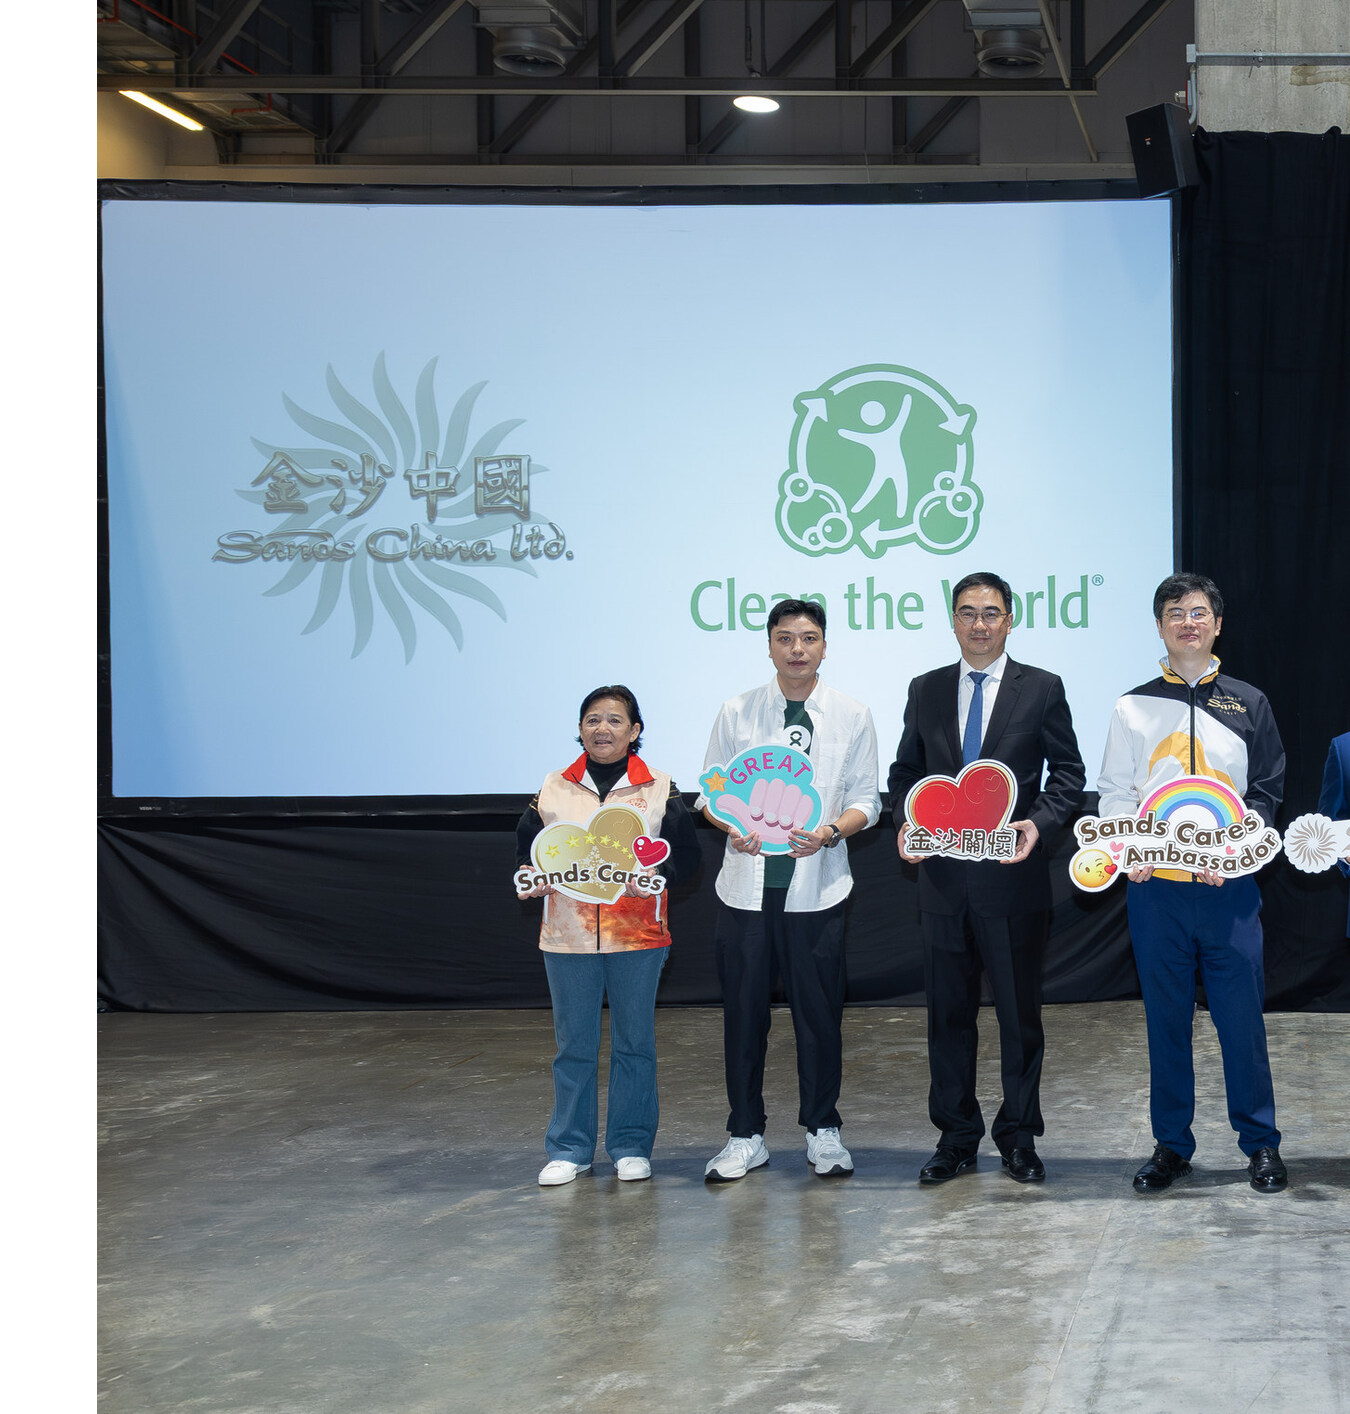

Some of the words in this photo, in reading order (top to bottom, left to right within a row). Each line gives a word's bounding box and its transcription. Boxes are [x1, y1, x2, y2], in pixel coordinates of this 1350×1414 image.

[250, 451, 531, 522] 金沙中國
[212, 528, 357, 561] Sands
[365, 522, 497, 561] China
[843, 576, 924, 631] the
[1207, 698, 1247, 713] Sands
[730, 752, 811, 784] GREAT
[908, 827, 1013, 856] 金沙關懷
[1080, 812, 1169, 843] Sands
[1176, 815, 1260, 845] Cares
[1126, 834, 1278, 872] Ambassador
[518, 863, 590, 891] Sands
[598, 864, 663, 891] Cares
